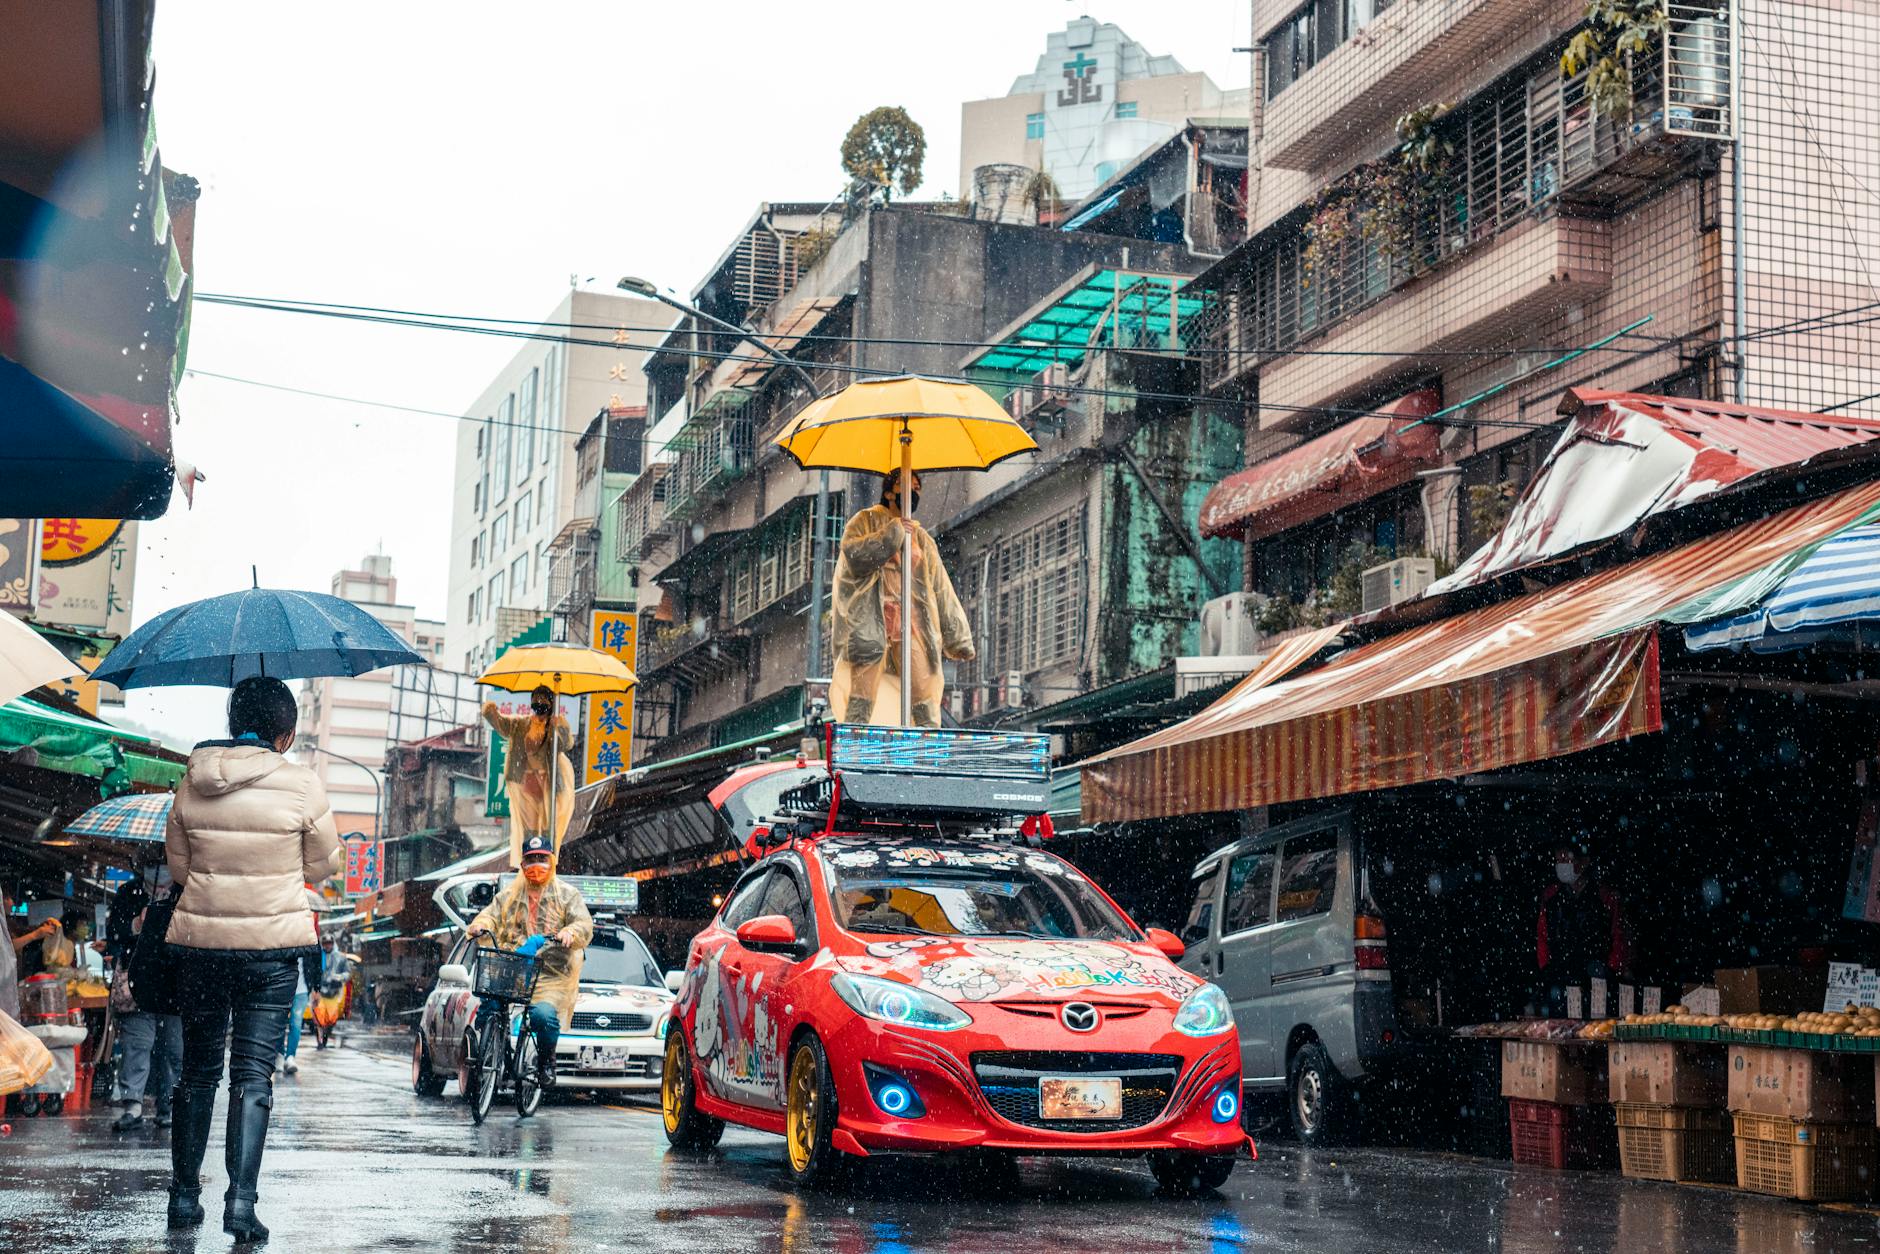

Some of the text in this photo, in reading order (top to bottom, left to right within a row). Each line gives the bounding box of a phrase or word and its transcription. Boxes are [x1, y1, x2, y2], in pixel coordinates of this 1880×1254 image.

[593, 619, 631, 776] 偉蔘藥
[993, 793, 1043, 802] COSMOS
